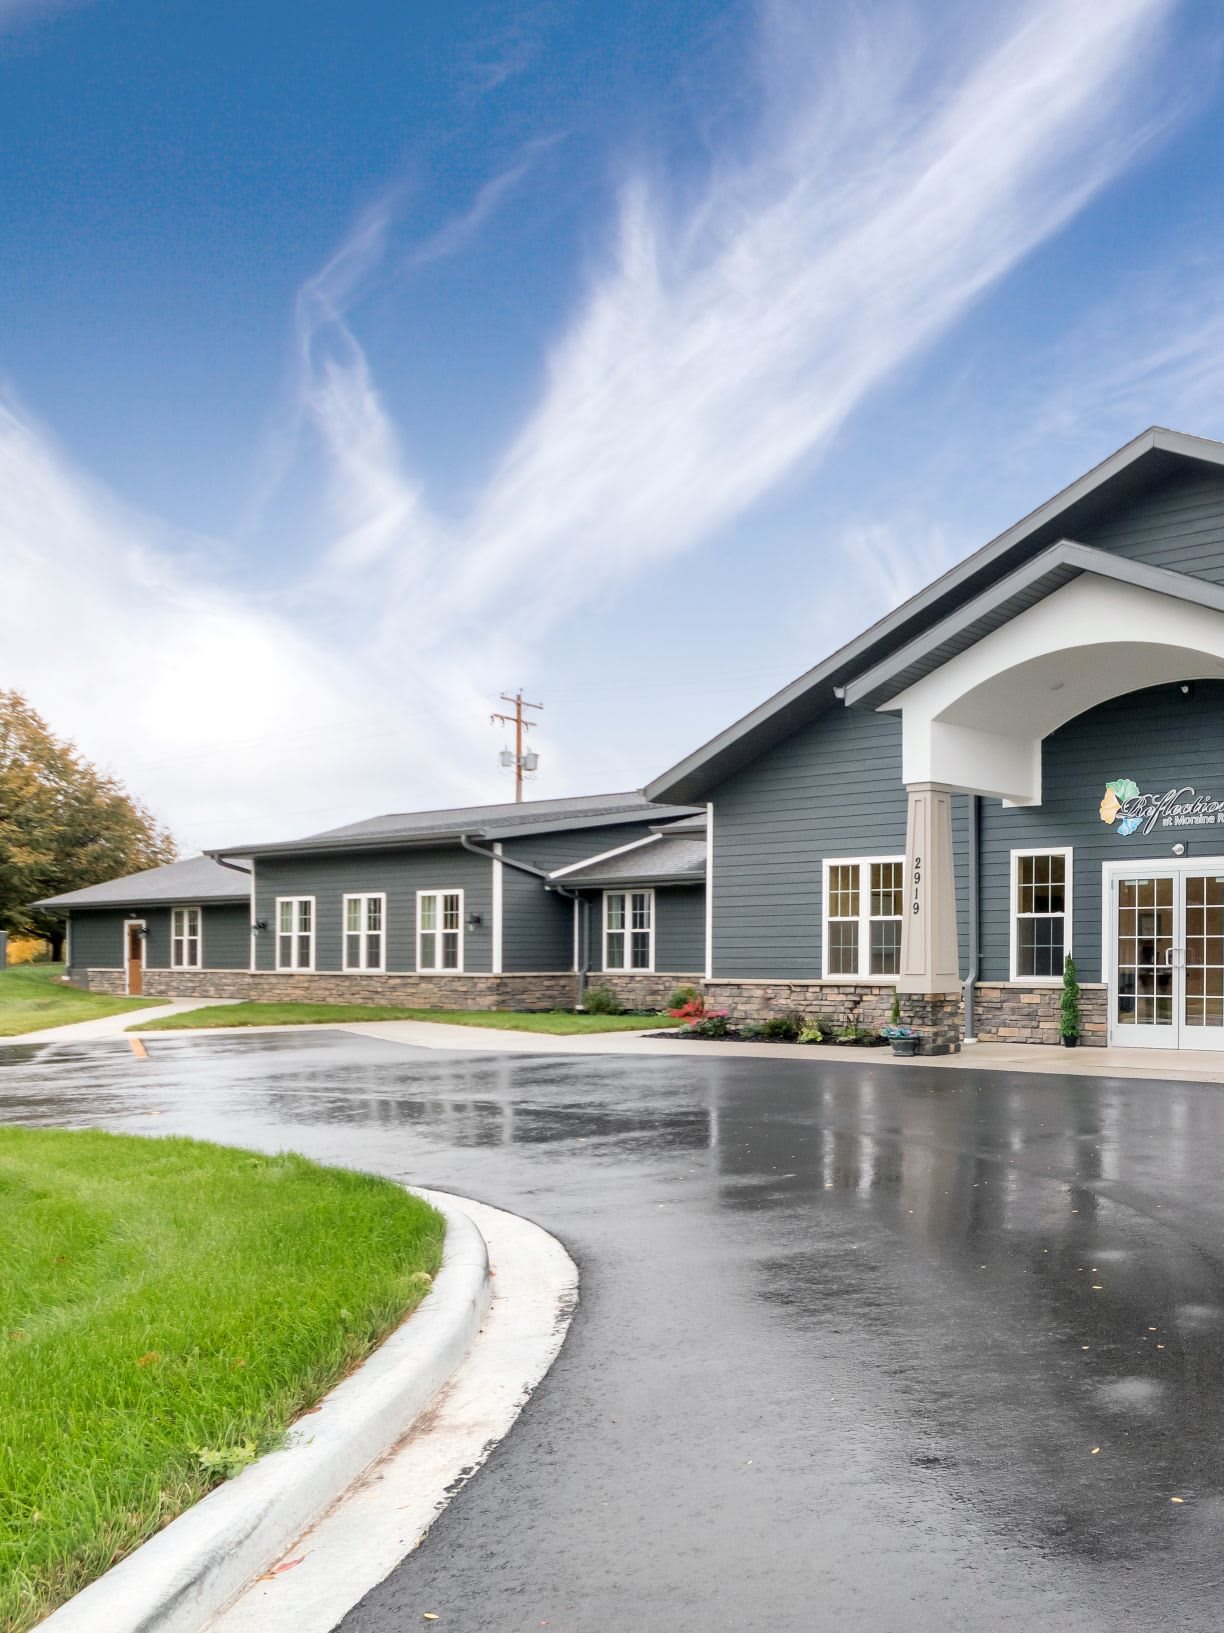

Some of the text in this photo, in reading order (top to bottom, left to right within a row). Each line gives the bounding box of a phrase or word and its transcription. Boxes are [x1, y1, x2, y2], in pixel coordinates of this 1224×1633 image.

[1162, 817, 1173, 827] at
[1174, 813, 1216, 826] Moraine
[912, 857, 921, 915] 2919
